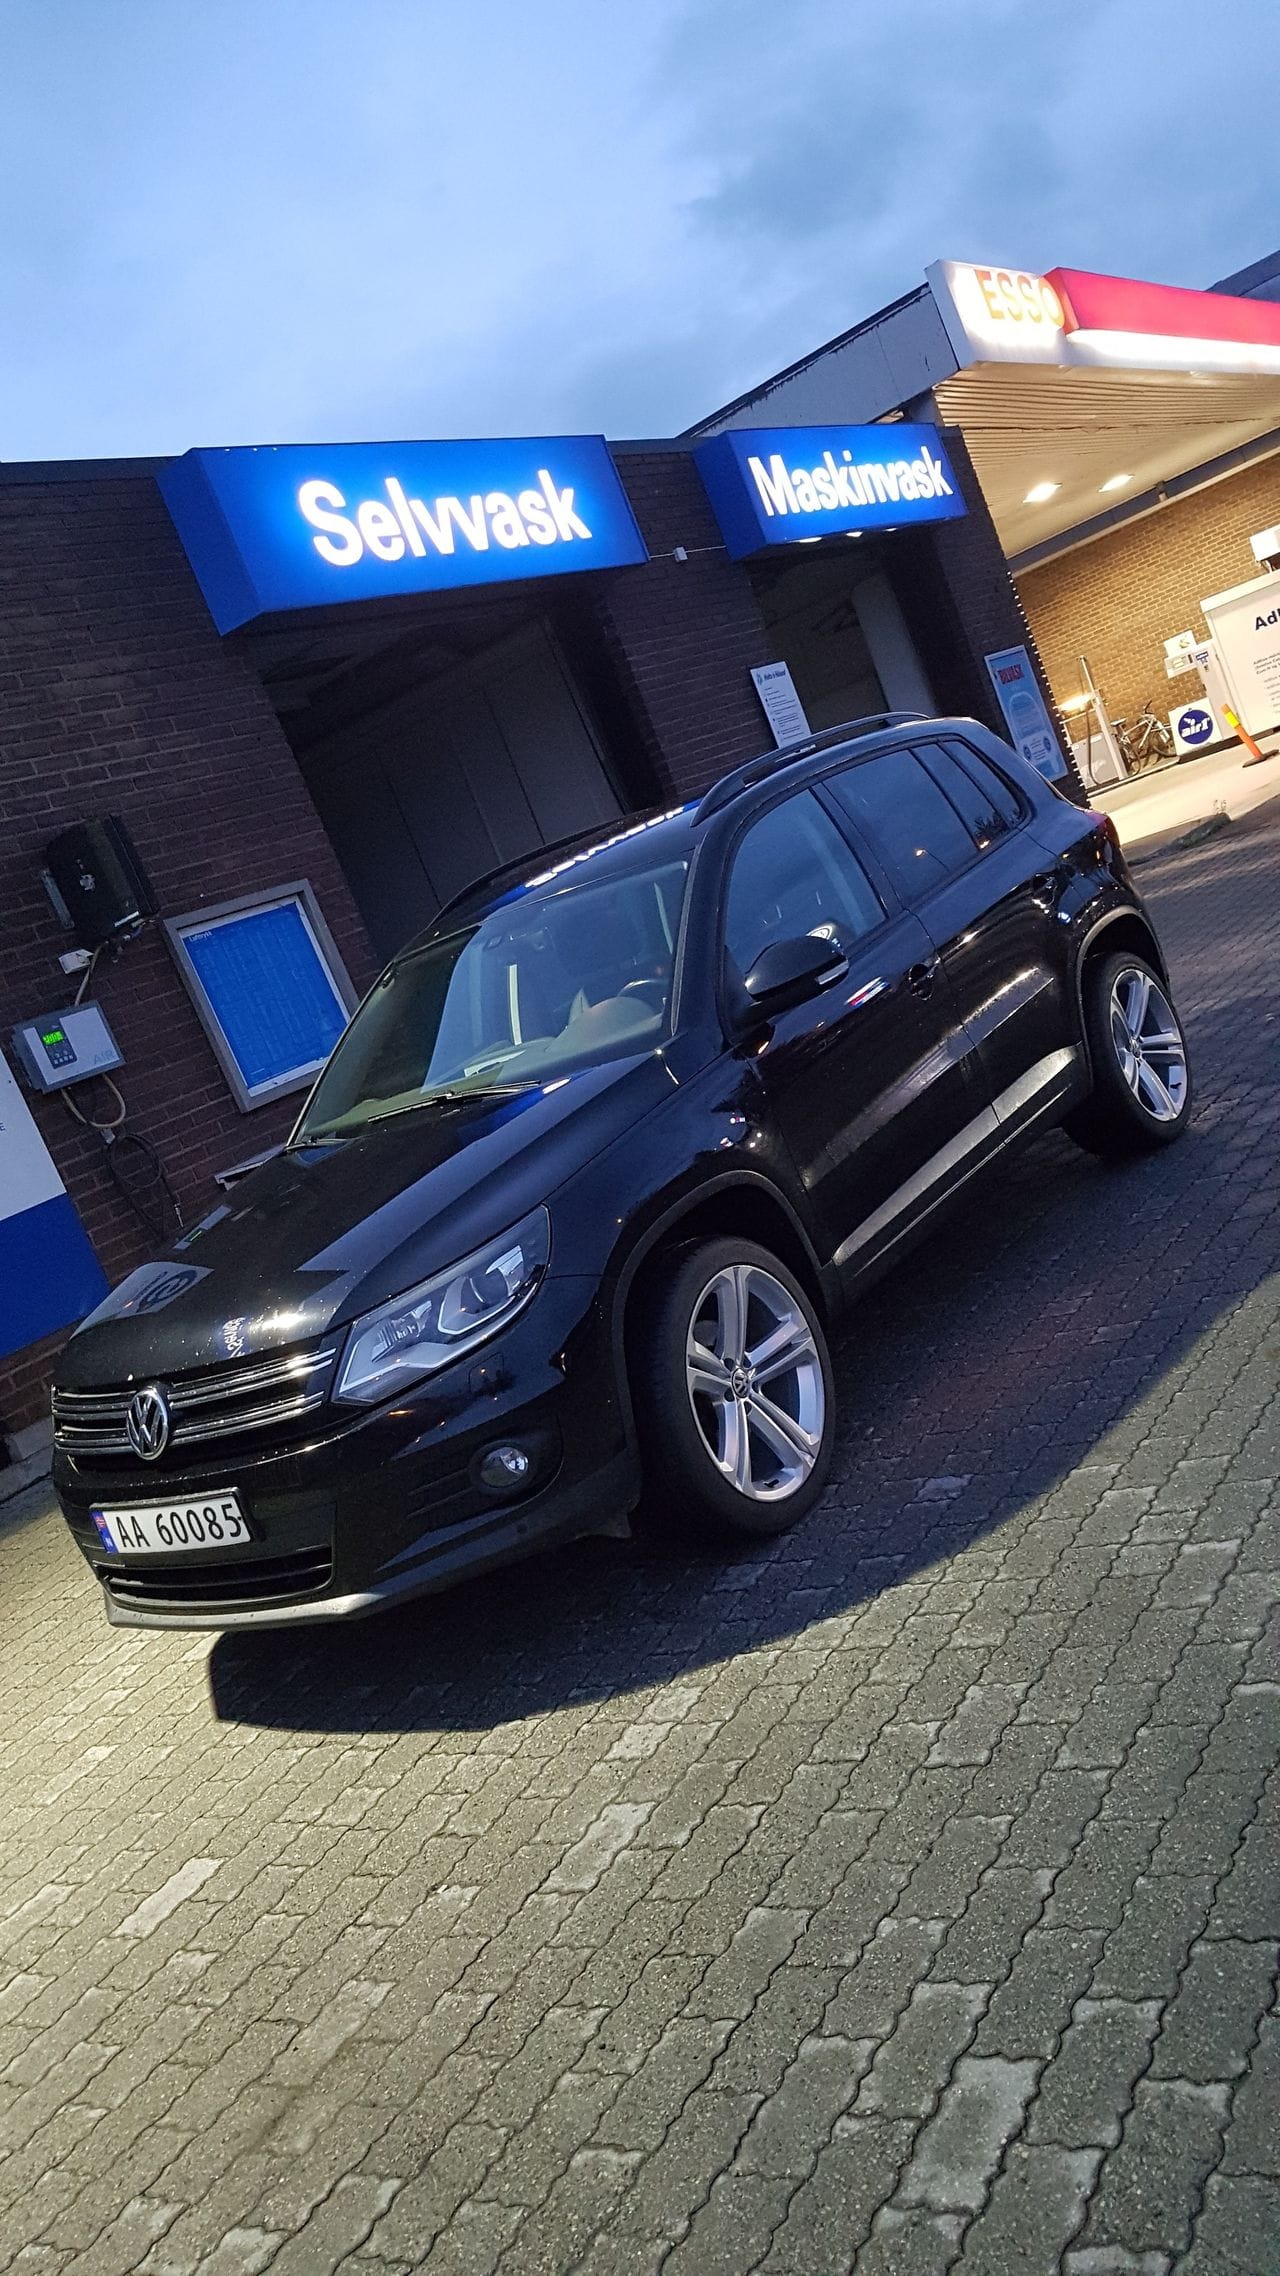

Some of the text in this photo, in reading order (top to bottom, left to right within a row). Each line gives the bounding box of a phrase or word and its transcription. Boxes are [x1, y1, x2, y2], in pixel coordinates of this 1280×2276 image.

[747, 446, 954, 517] Maskinvask
[298, 468, 593, 567] Selvvask
[115, 1503, 242, 1548] AA 60085
